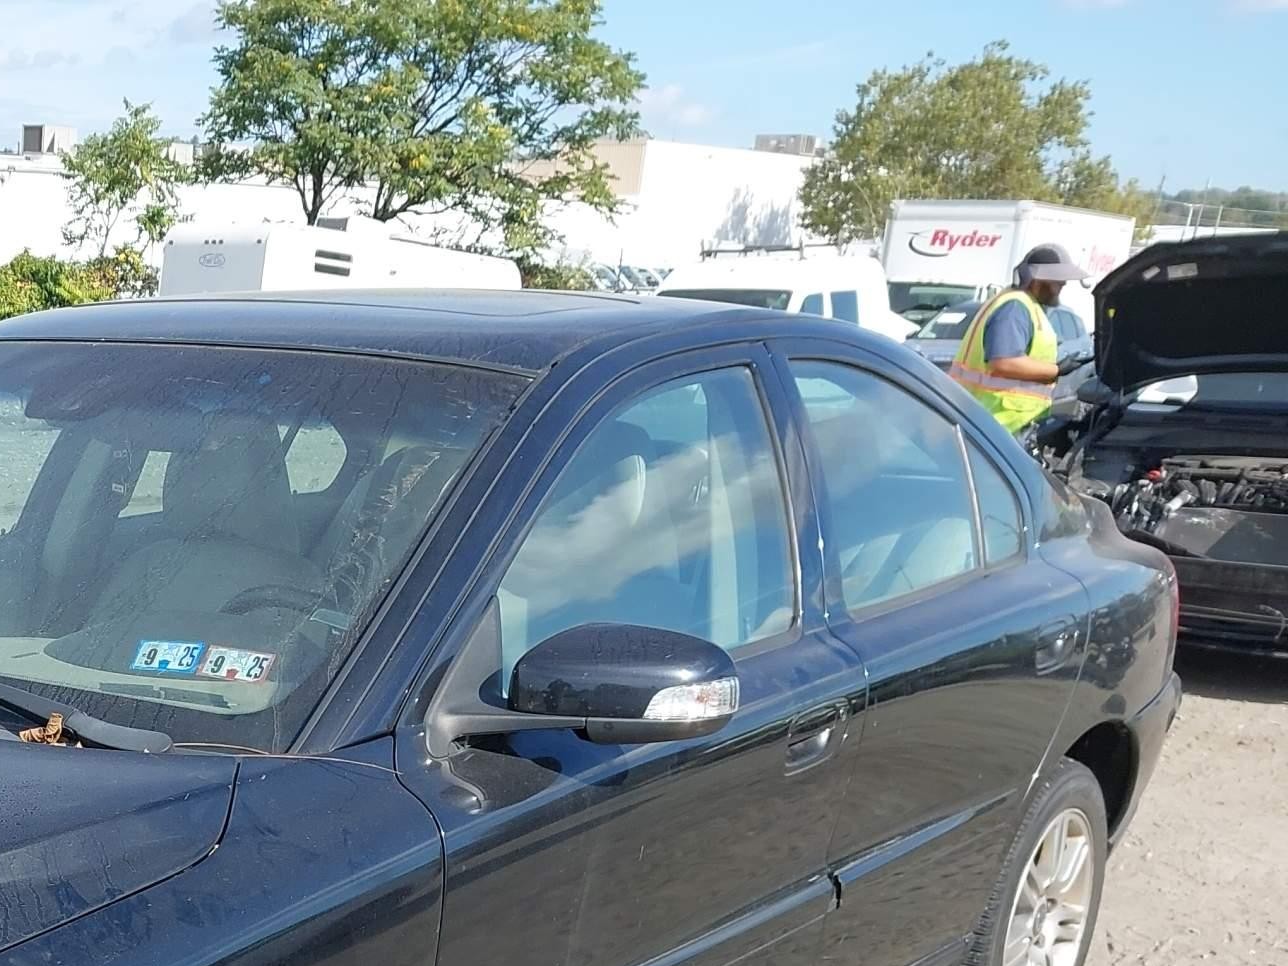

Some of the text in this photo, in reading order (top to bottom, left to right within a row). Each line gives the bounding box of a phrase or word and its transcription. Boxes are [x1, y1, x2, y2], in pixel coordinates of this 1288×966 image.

[929, 229, 1002, 251] Ryder
[144, 646, 199, 667] 9 25
[211, 655, 268, 679] 9 25
